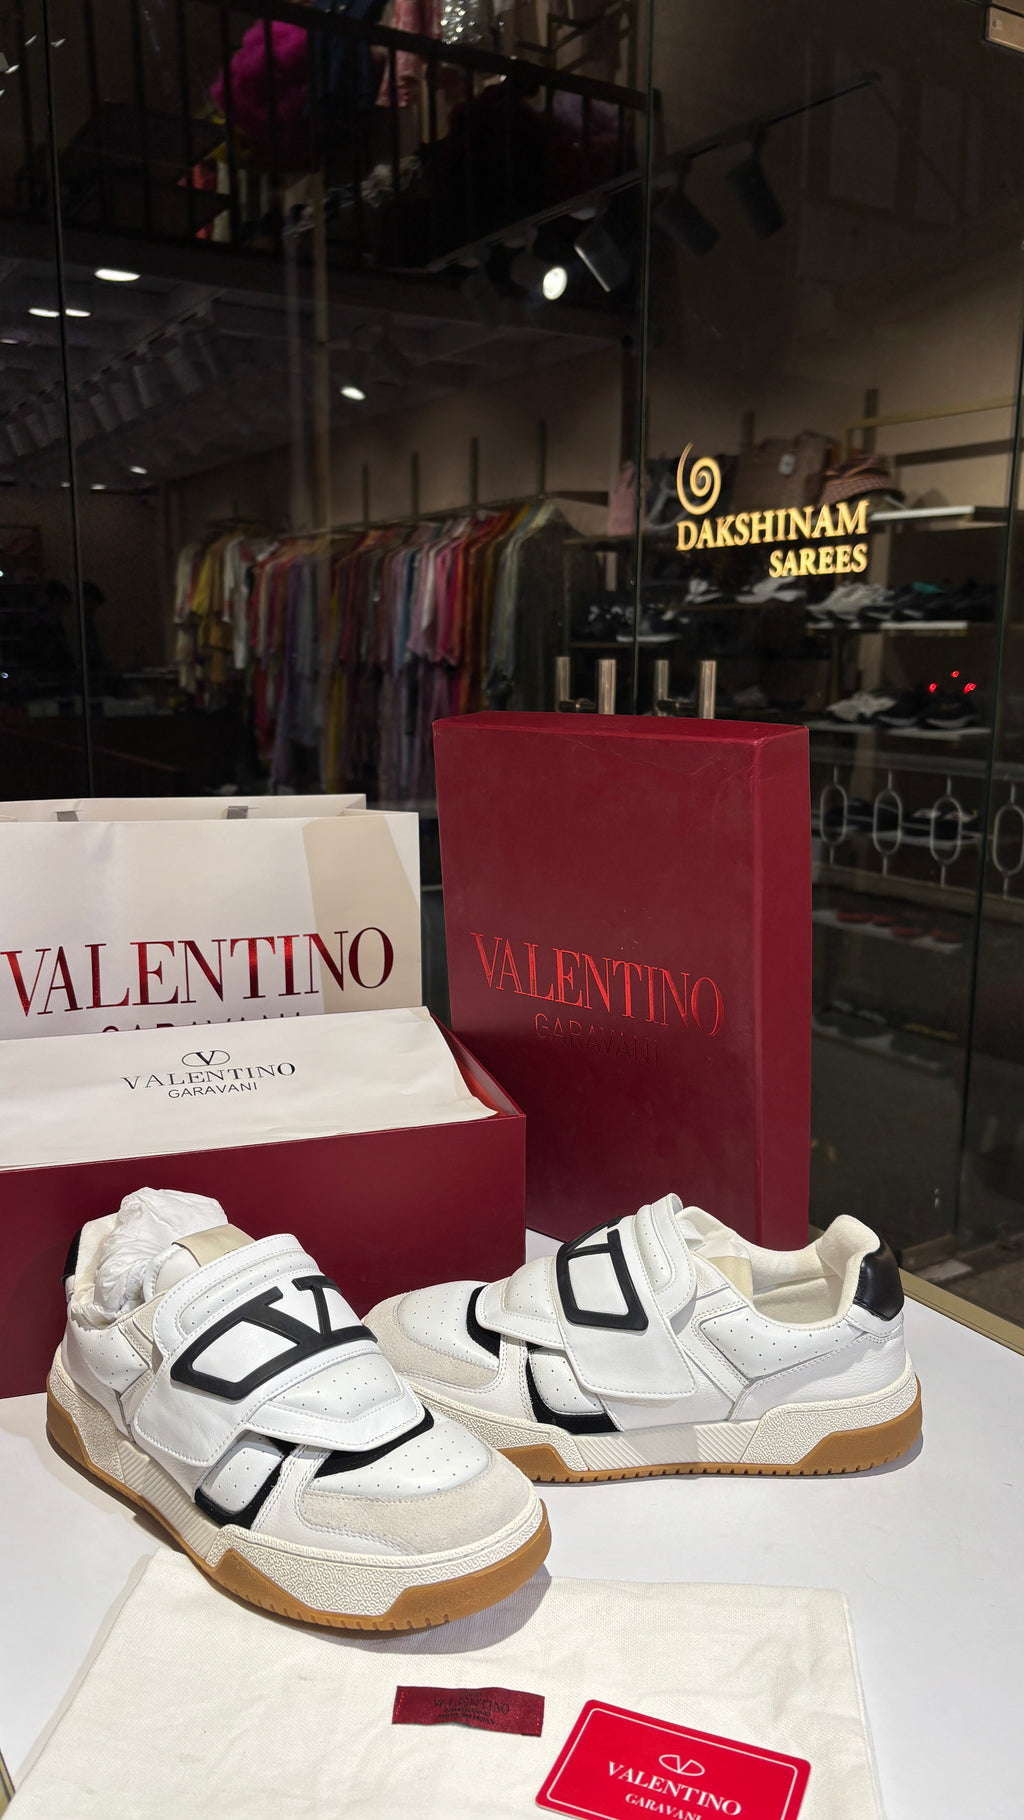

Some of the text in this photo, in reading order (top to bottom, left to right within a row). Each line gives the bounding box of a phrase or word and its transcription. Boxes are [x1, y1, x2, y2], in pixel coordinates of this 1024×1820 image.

[676, 500, 869, 551] DAKSHINAM
[768, 543, 868, 578] SAREES
[0, 926, 394, 1018] VALENTINO
[470, 932, 724, 1038] VALENTINO
[535, 1013, 659, 1066] GARAVANI
[121, 1062, 296, 1090] VALENTINO
[168, 1081, 258, 1098] GARAVANI
[608, 1761, 741, 1816] VALENTINO
[625, 1793, 702, 1820] GARAVANI
